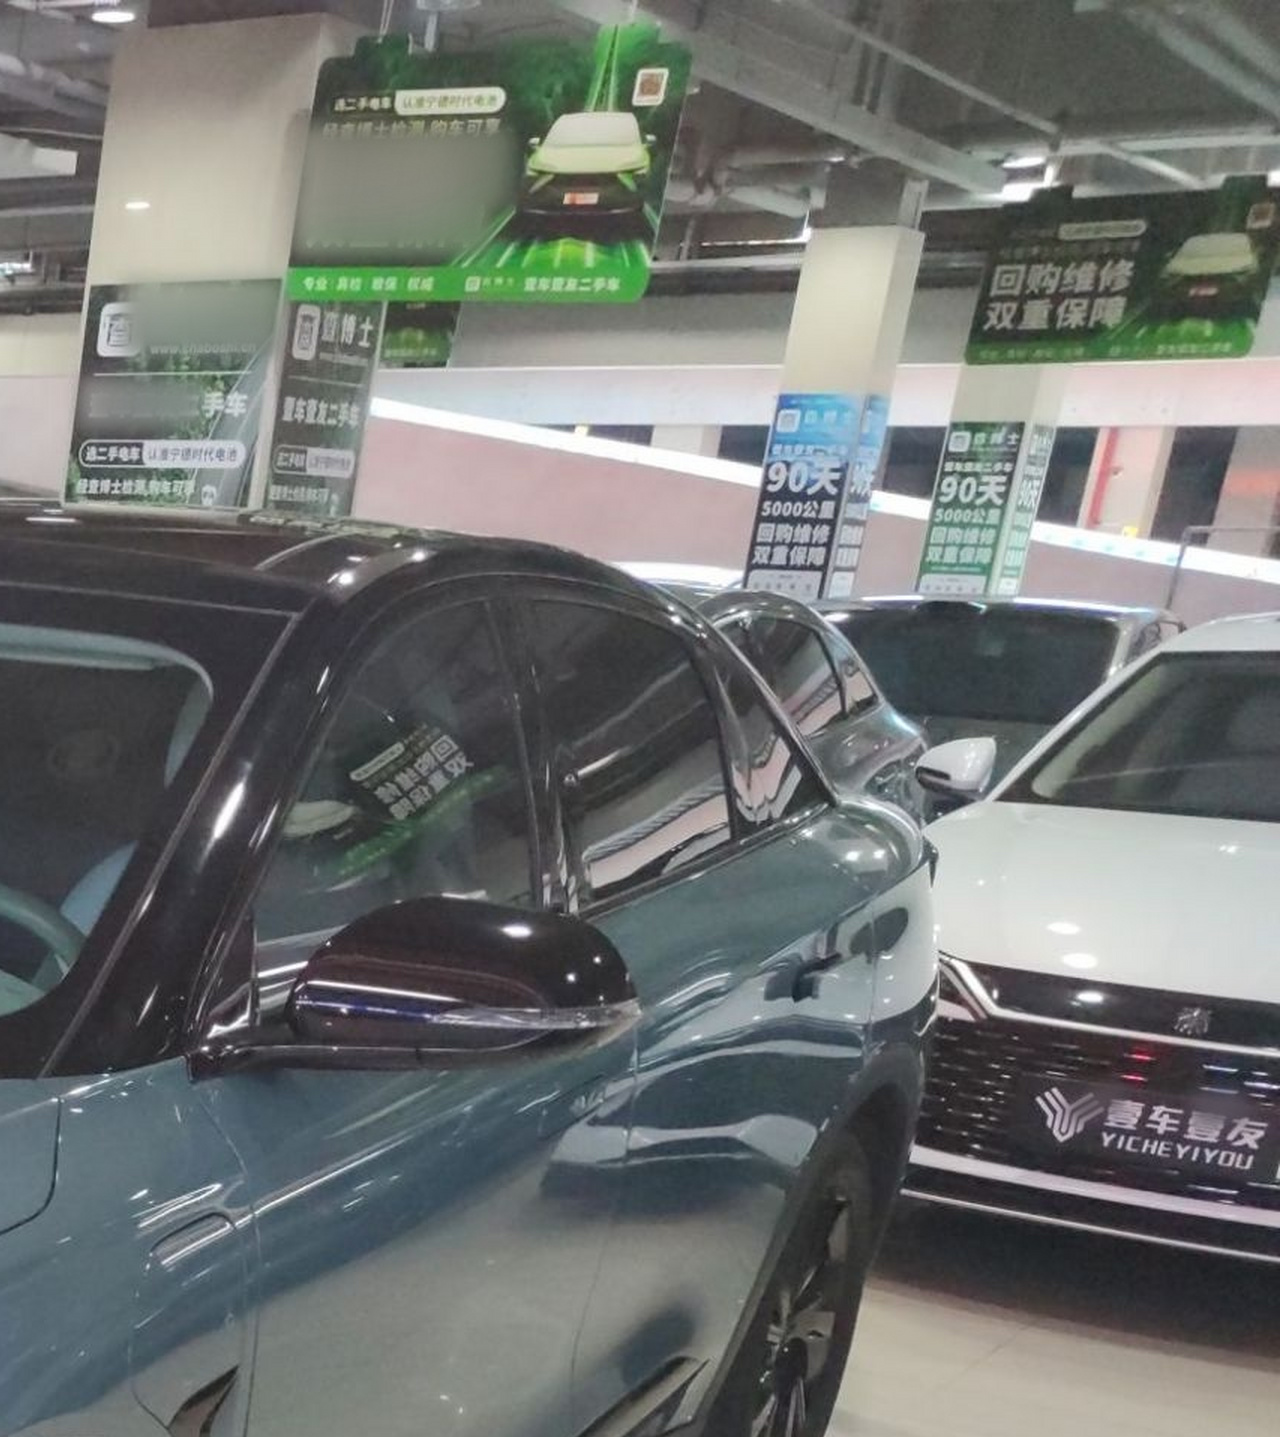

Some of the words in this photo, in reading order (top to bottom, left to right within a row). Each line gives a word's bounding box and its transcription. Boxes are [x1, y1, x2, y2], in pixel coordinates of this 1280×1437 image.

[990, 259, 1135, 298] 回购维修
[983, 296, 1128, 331] 双重保障
[85, 446, 140, 462] 选二手电车
[148, 448, 237, 463] 认准宁德时代电池
[766, 456, 841, 495] 90天
[939, 475, 1008, 505] 90天
[761, 500, 836, 519] 5000公里
[934, 508, 1002, 525] 5000公里
[755, 522, 830, 544] 回购维修
[751, 544, 827, 566] 双重保障
[1104, 1099, 1269, 1149] 壹车壹友
[1101, 1131, 1255, 1170] YICHEYIYOU
